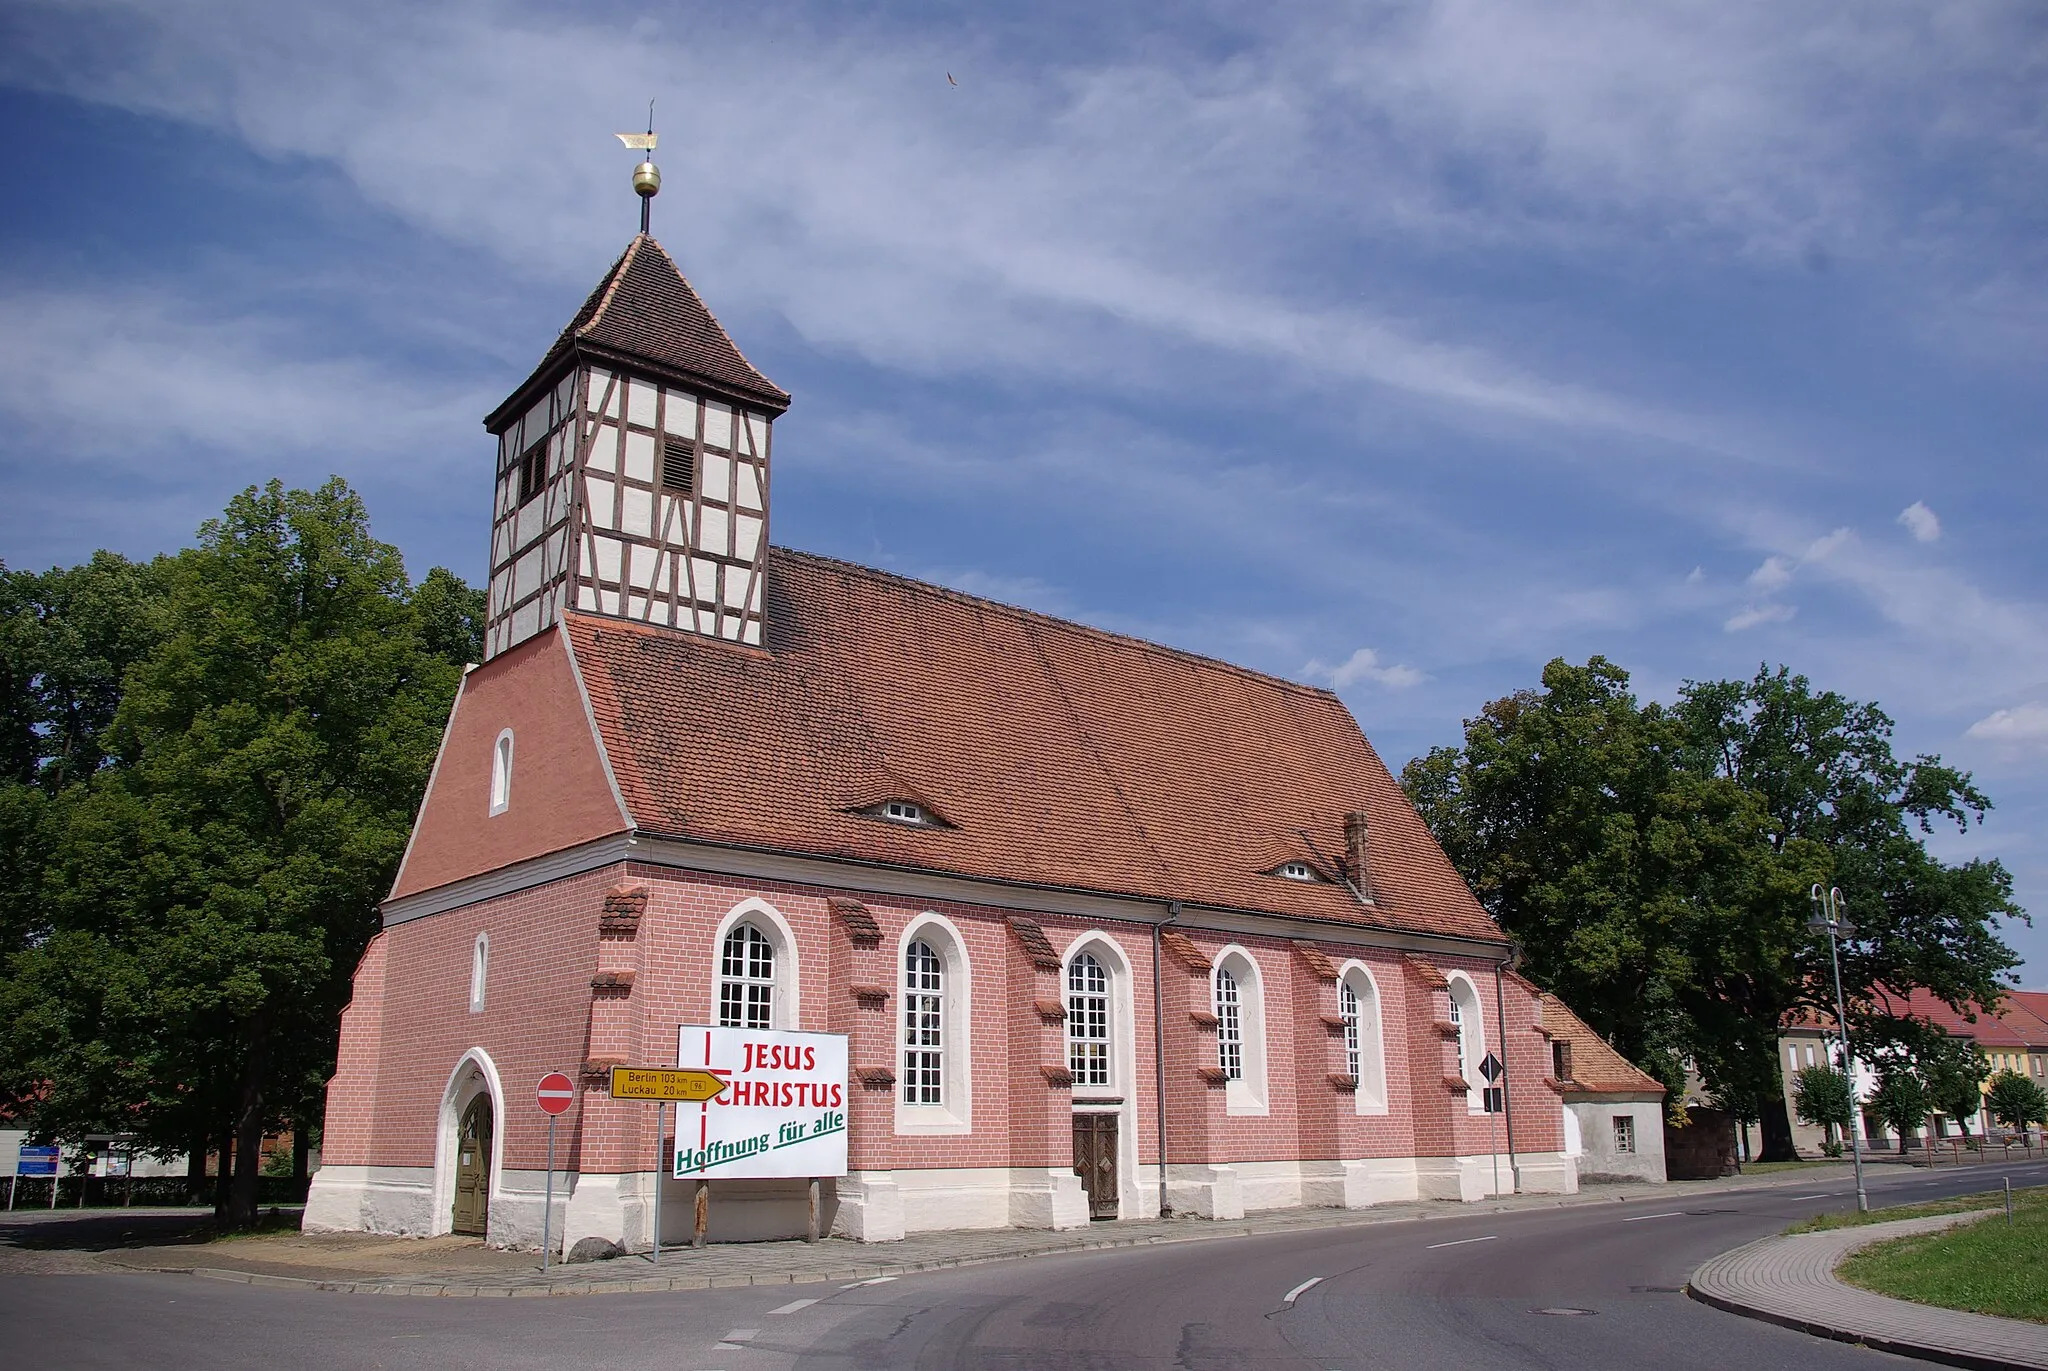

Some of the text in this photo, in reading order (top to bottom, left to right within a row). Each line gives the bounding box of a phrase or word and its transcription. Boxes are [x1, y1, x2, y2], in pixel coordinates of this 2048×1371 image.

[742, 1043, 815, 1073] JESUS
[628, 1071, 688, 1084] Berlin 103 km
[622, 1084, 687, 1096] Luckau 20 km
[694, 1082, 702, 1090] 96
[676, 1110, 844, 1171] Hoffnung für alle
